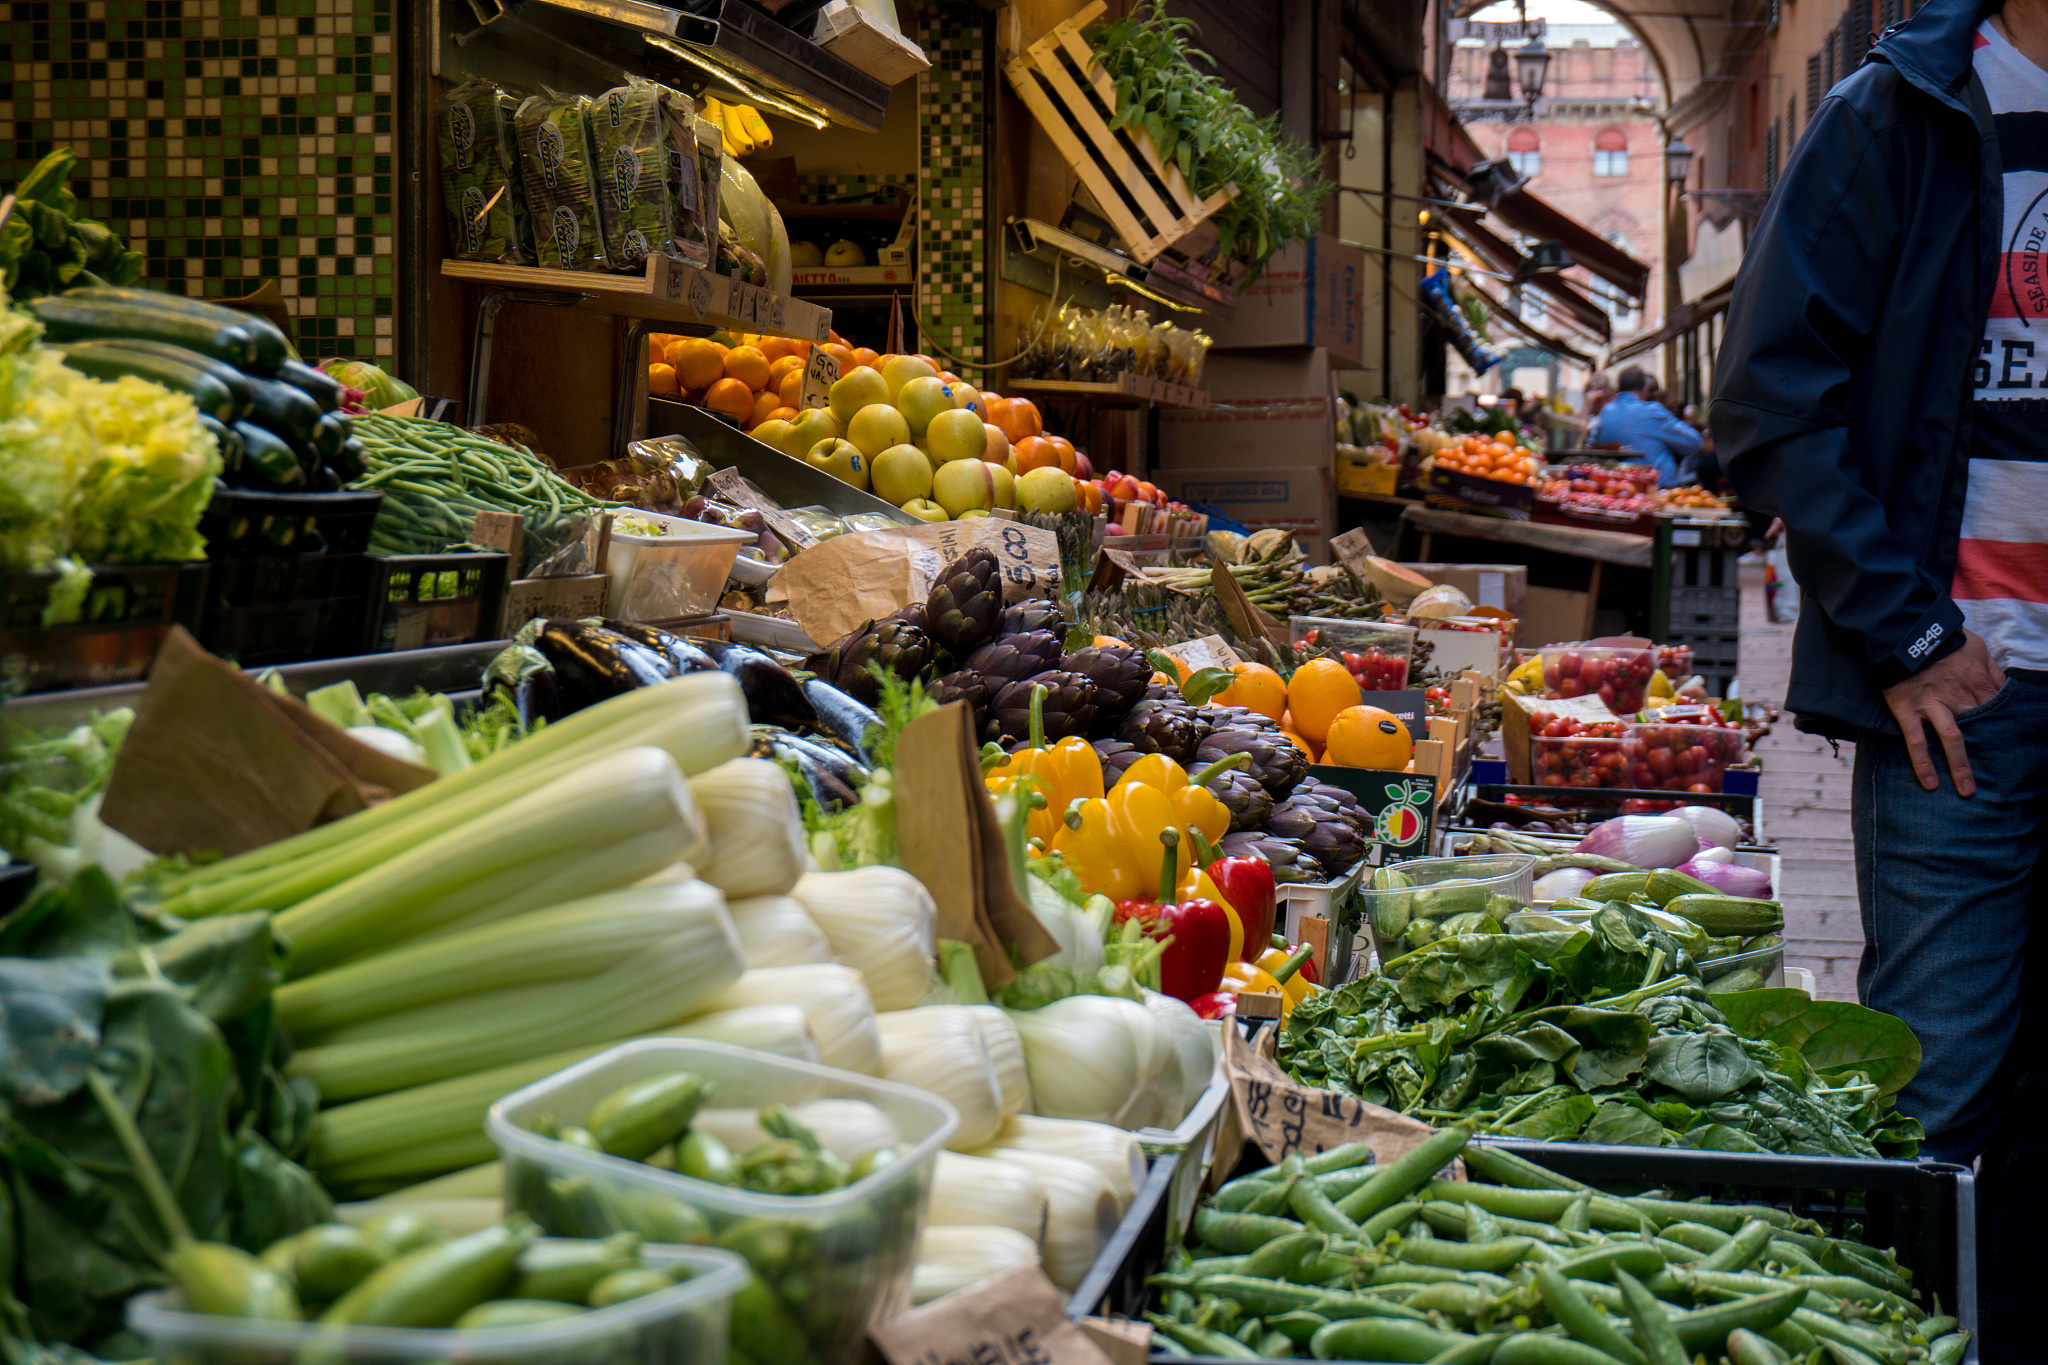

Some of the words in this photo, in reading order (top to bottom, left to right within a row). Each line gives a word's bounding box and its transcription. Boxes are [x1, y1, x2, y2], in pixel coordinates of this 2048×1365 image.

[541, 141, 556, 187] ORTO
[617, 166, 629, 211] ORTO
[2022, 225, 2048, 313] SEASIDE
[1972, 339, 2048, 389] SE
[1907, 622, 1944, 659] 8848
